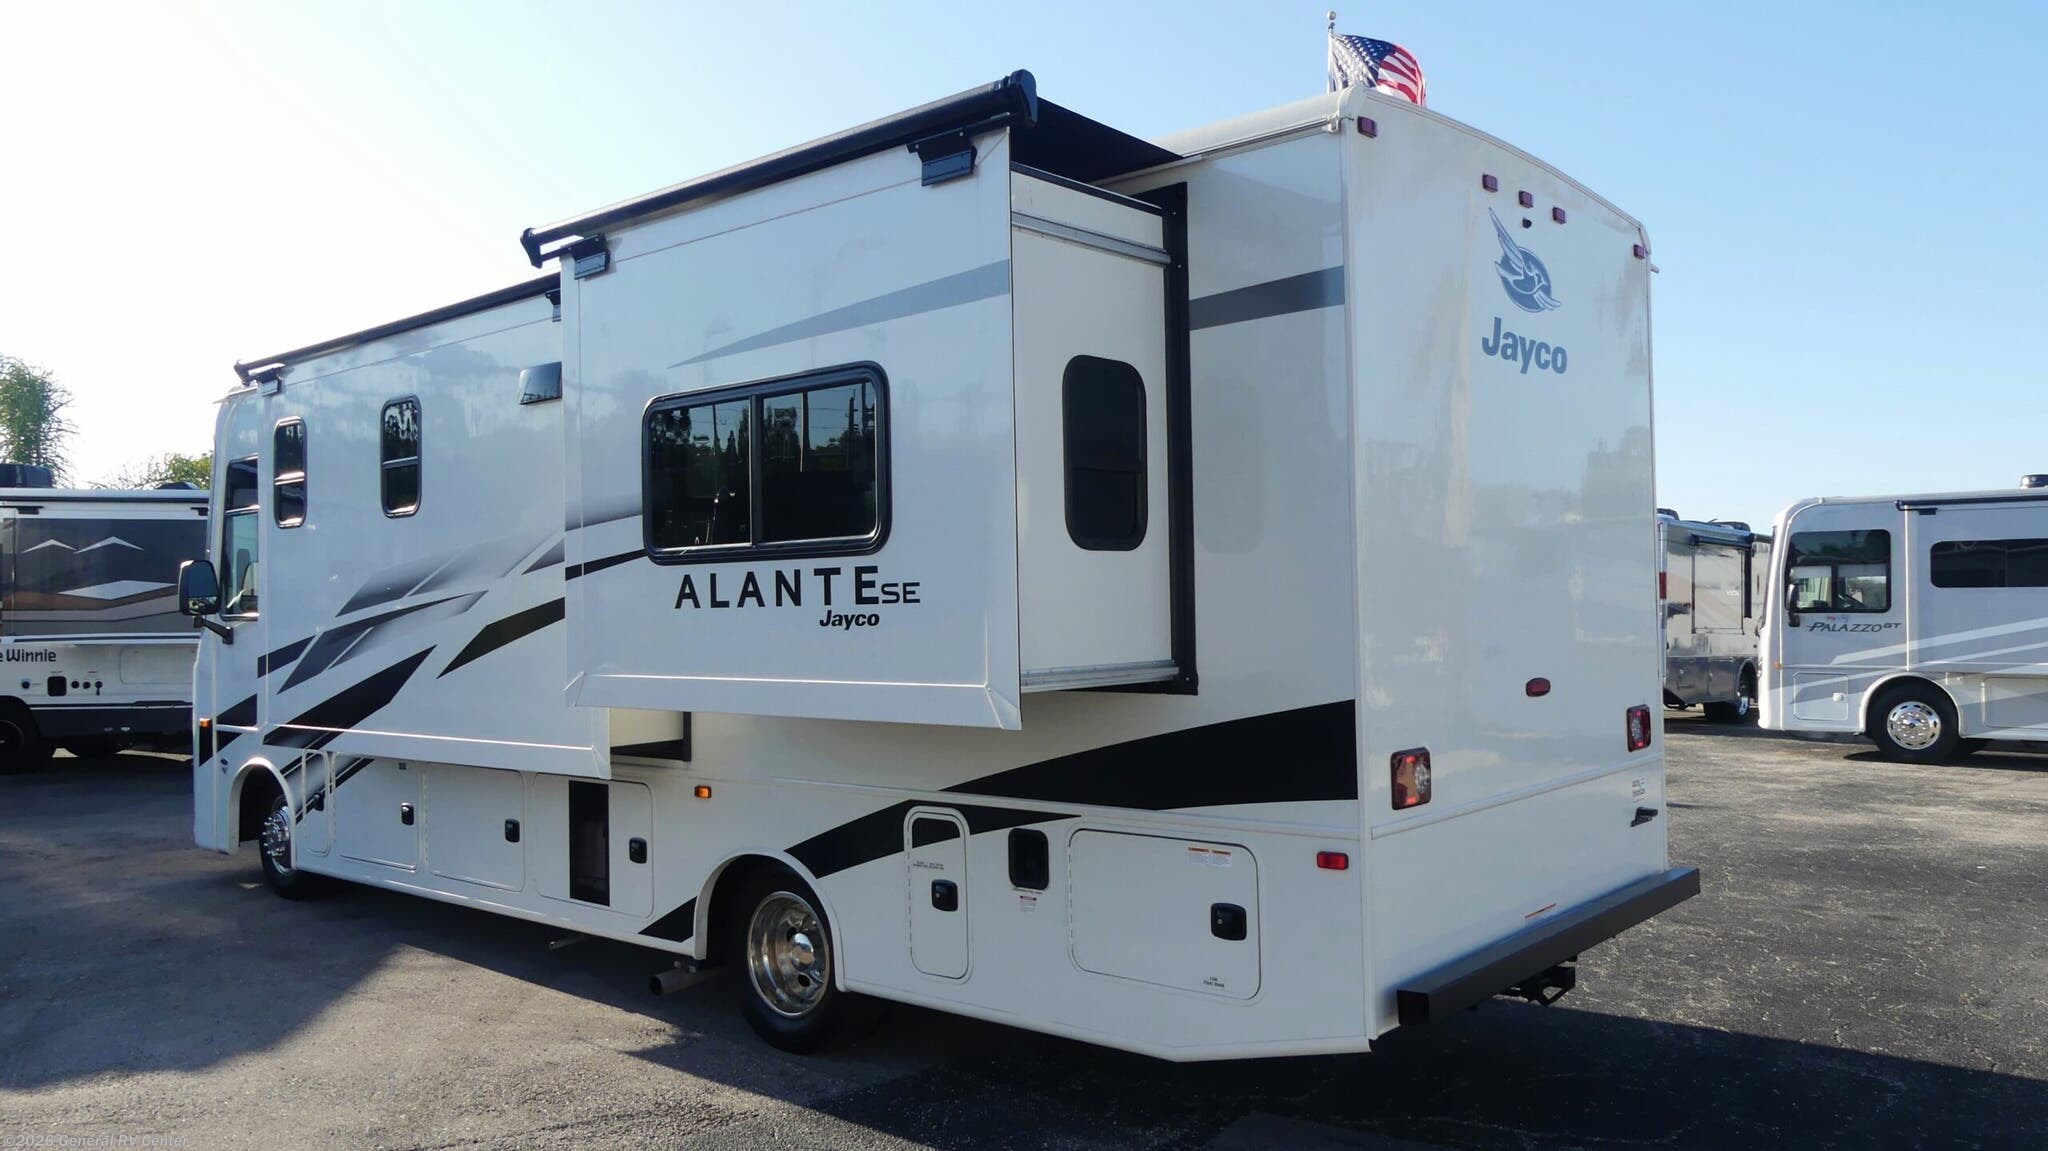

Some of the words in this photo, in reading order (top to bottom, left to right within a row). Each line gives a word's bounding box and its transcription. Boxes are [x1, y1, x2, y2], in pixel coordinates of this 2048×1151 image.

[1482, 316, 1568, 374] Jayco
[674, 565, 879, 609] ALANTE
[819, 609, 880, 630] Jayco
[1806, 621, 1882, 633] PALAZZO
[6, 648, 57, 662] Winnie
